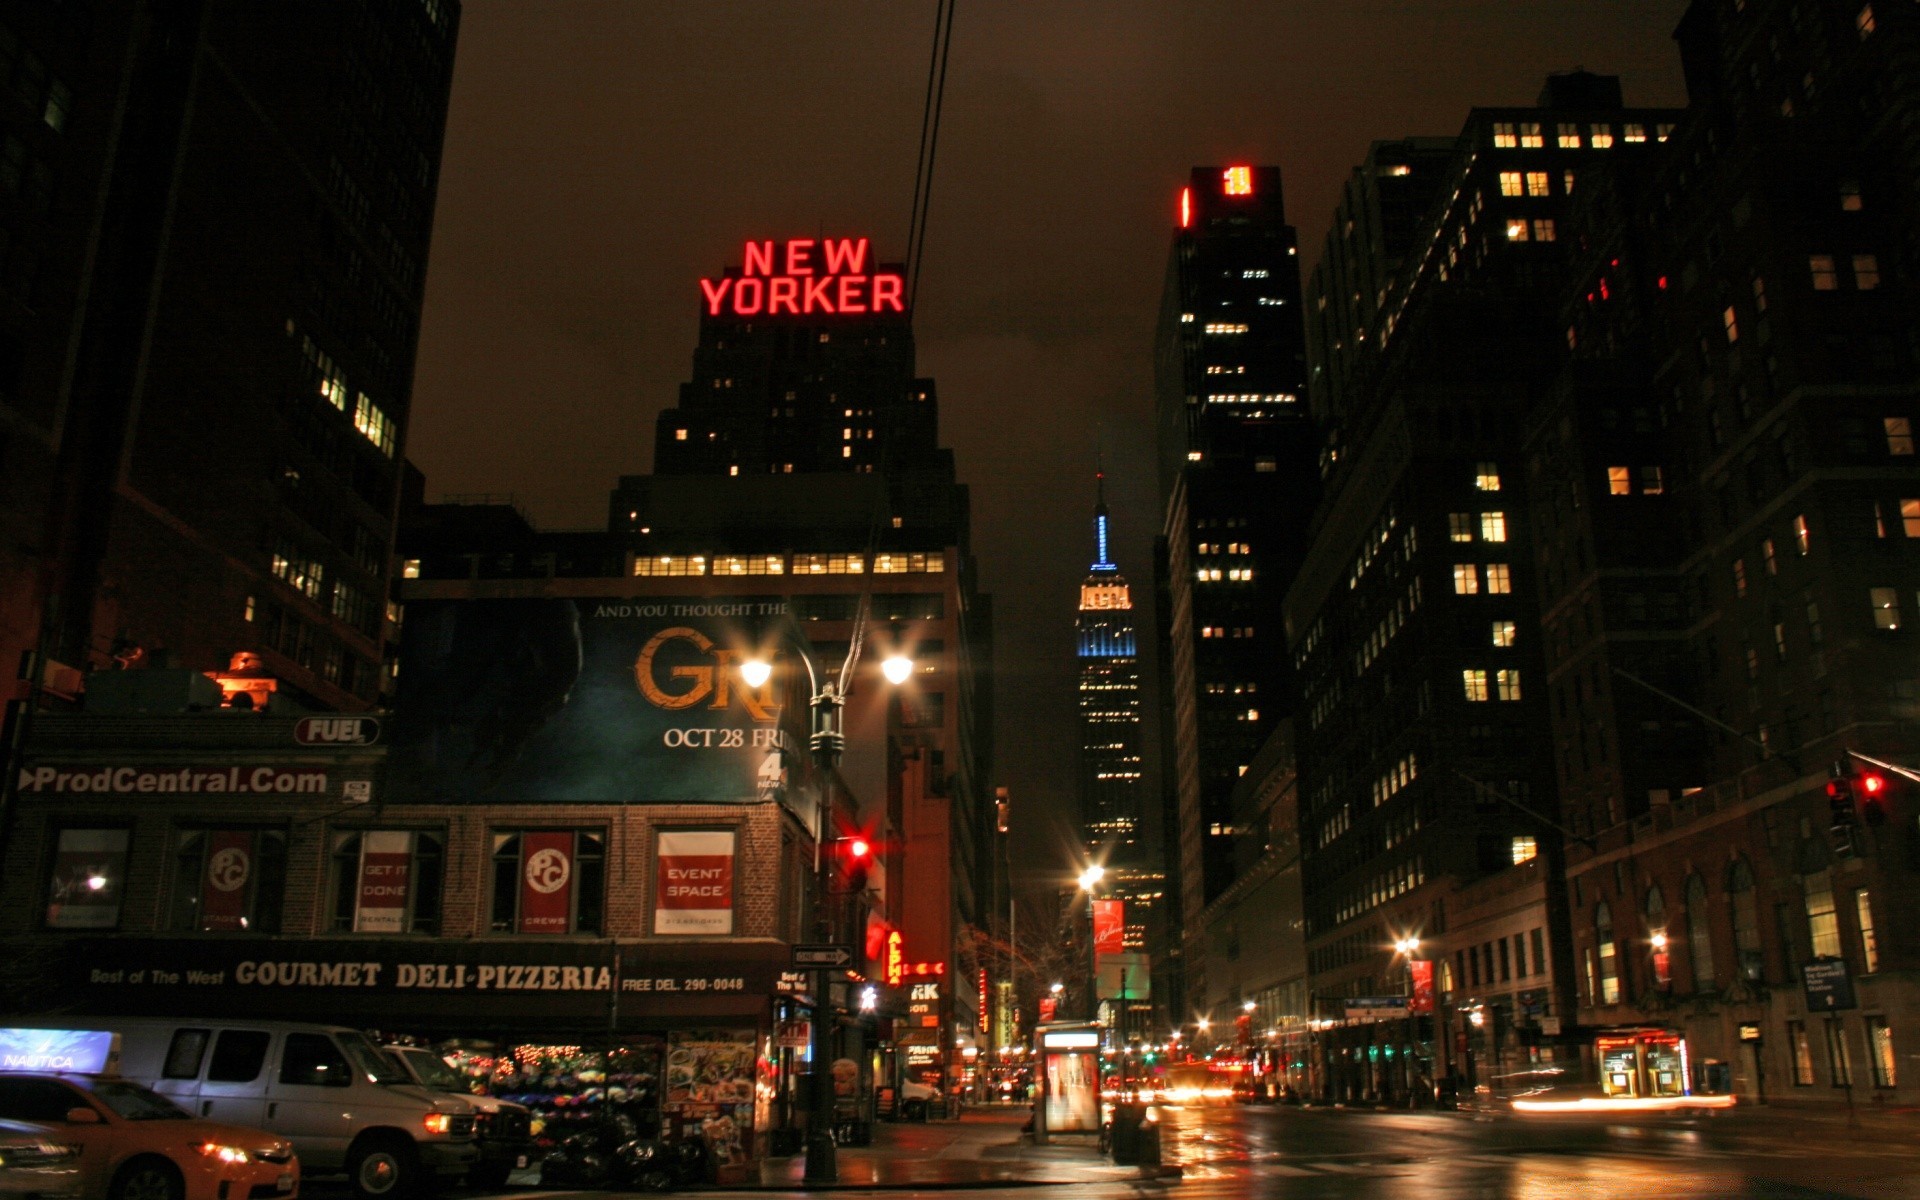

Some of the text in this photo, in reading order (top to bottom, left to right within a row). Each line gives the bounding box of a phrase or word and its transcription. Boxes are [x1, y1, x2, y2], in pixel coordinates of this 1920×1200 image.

[744, 239, 868, 276] NEW
[701, 274, 904, 315] YORKER
[594, 602, 788, 618] AND YOU THOUGHT THE
[307, 719, 366, 742] FUEL
[664, 728, 716, 748] OCT
[718, 728, 744, 748] 28
[33, 766, 328, 793] ProdCentral.Com
[365, 864, 408, 875] GET IT
[667, 868, 723, 879] EVENT
[363, 886, 407, 896] DONE
[667, 885, 723, 897] SPACE
[525, 917, 567, 925] CREWS
[151, 970, 181, 984] The
[236, 961, 382, 987] GOURMET
[622, 979, 652, 991] FREE
[684, 978, 744, 990] 290-0048
[3, 1054, 74, 1069] NAUTICA
